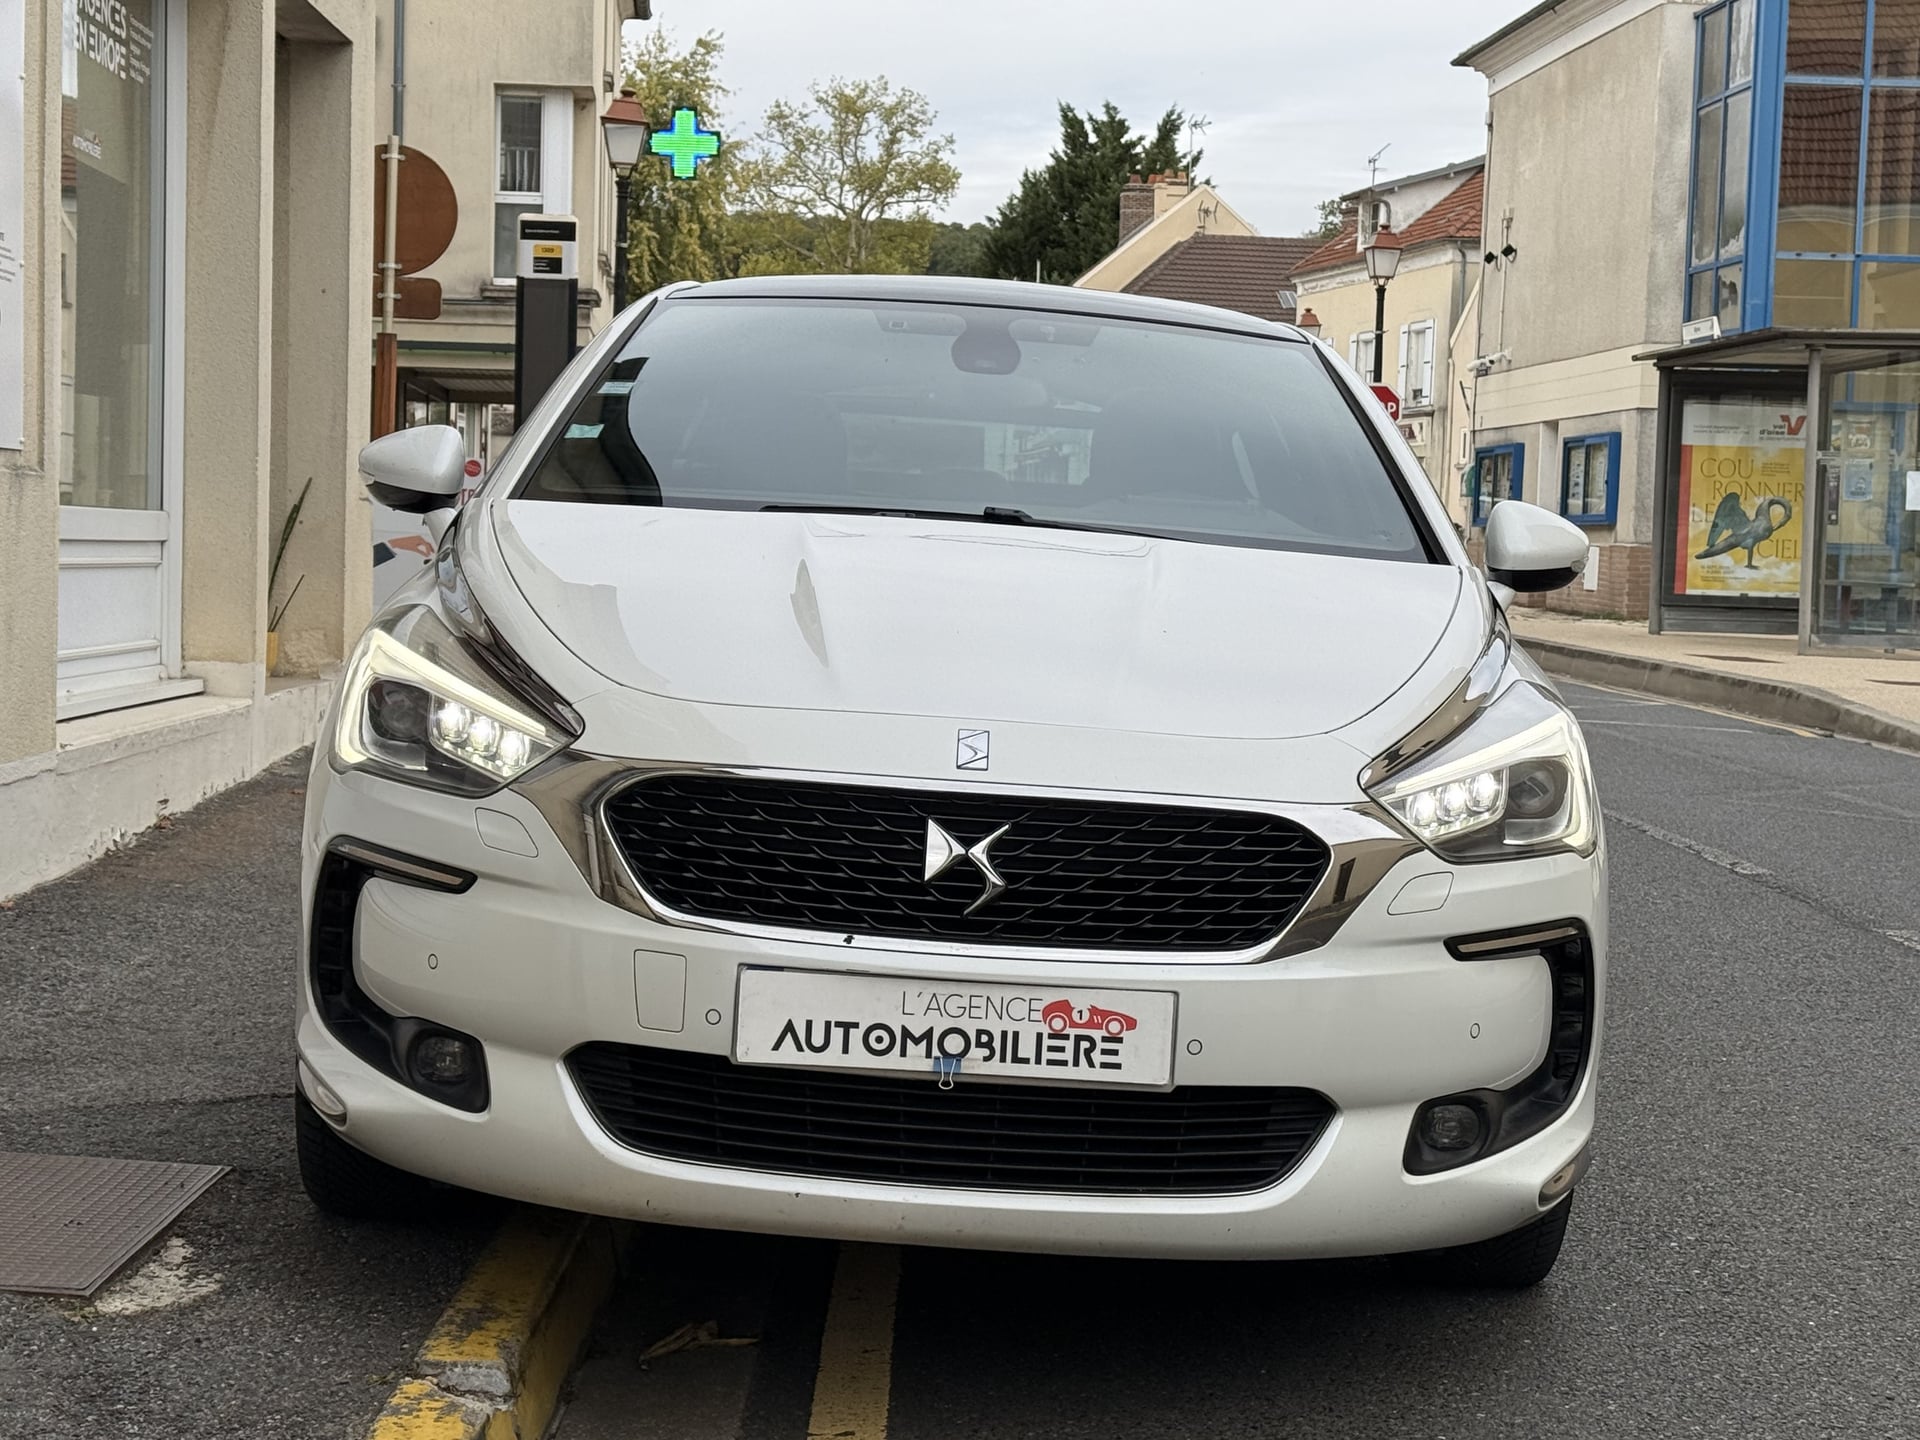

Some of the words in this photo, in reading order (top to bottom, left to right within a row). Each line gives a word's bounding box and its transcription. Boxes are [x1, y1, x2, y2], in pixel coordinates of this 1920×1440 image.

[74, 15, 88, 55] EN
[89, 24, 127, 80] EUROPE
[1700, 457, 1754, 479] COU
[1712, 480, 1805, 502] RONNER
[1691, 502, 1716, 523] LE
[901, 990, 1044, 1023] L'AGENCE
[771, 1017, 1125, 1071] AUTOMOBILIERE
